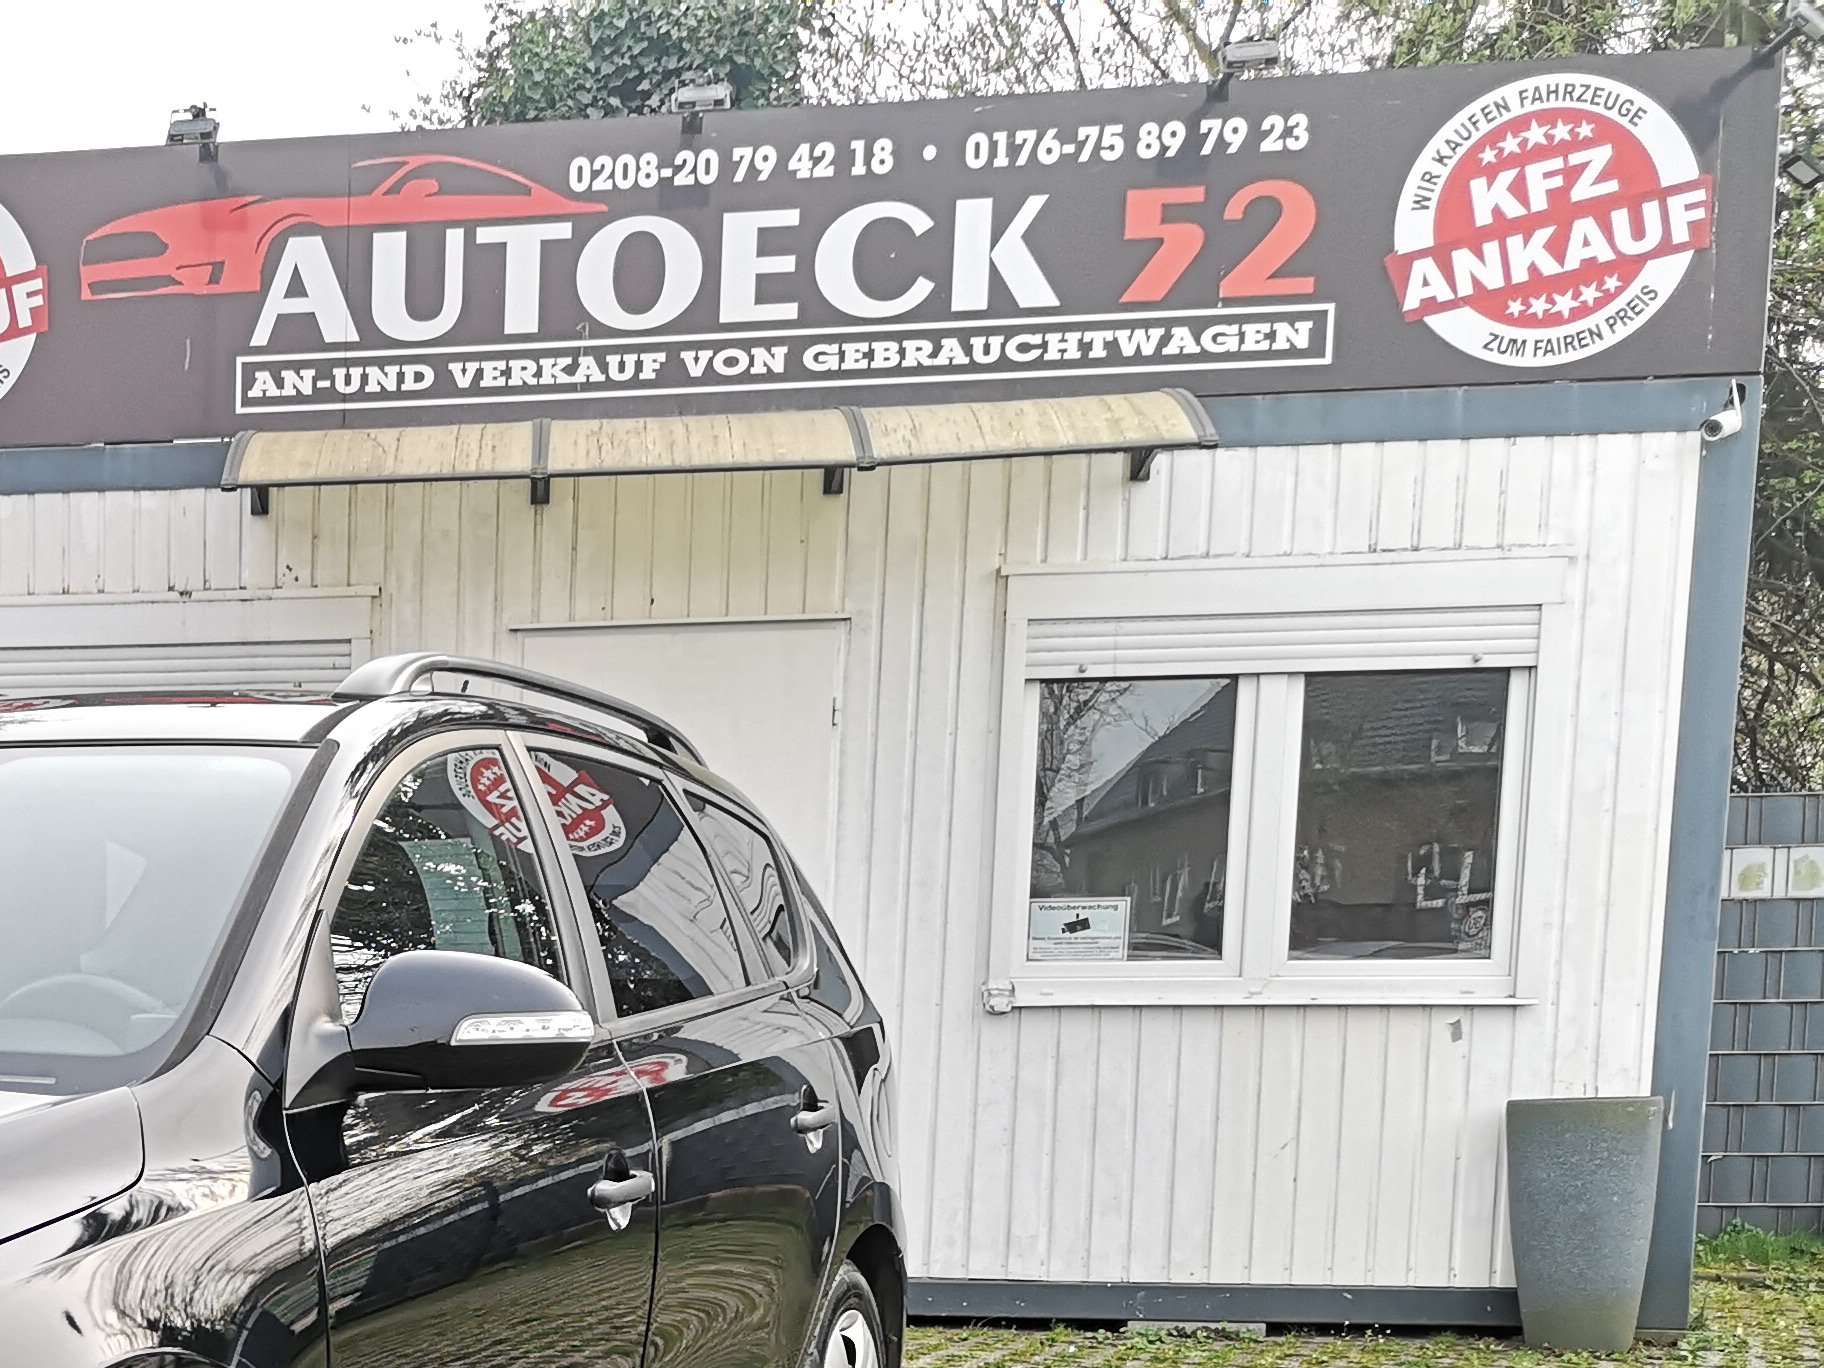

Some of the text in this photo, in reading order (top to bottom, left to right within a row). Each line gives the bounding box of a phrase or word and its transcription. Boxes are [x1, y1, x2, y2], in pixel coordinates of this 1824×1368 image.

[569, 112, 1310, 192] 0208-20 79 42 18 0176-75 89 79 23
[1411, 82, 1648, 212] WIR KAUFEN FAHRZEUGE
[1468, 143, 1620, 227] KFZ
[248, 179, 1318, 347] AUTOECK 52
[1402, 188, 1708, 312] ANKAUF
[247, 321, 1313, 399] AN-UND VERKAUF VON GEBRAUCHTWAGEN
[1482, 284, 1658, 358] ZUM FAIREN PREIS
